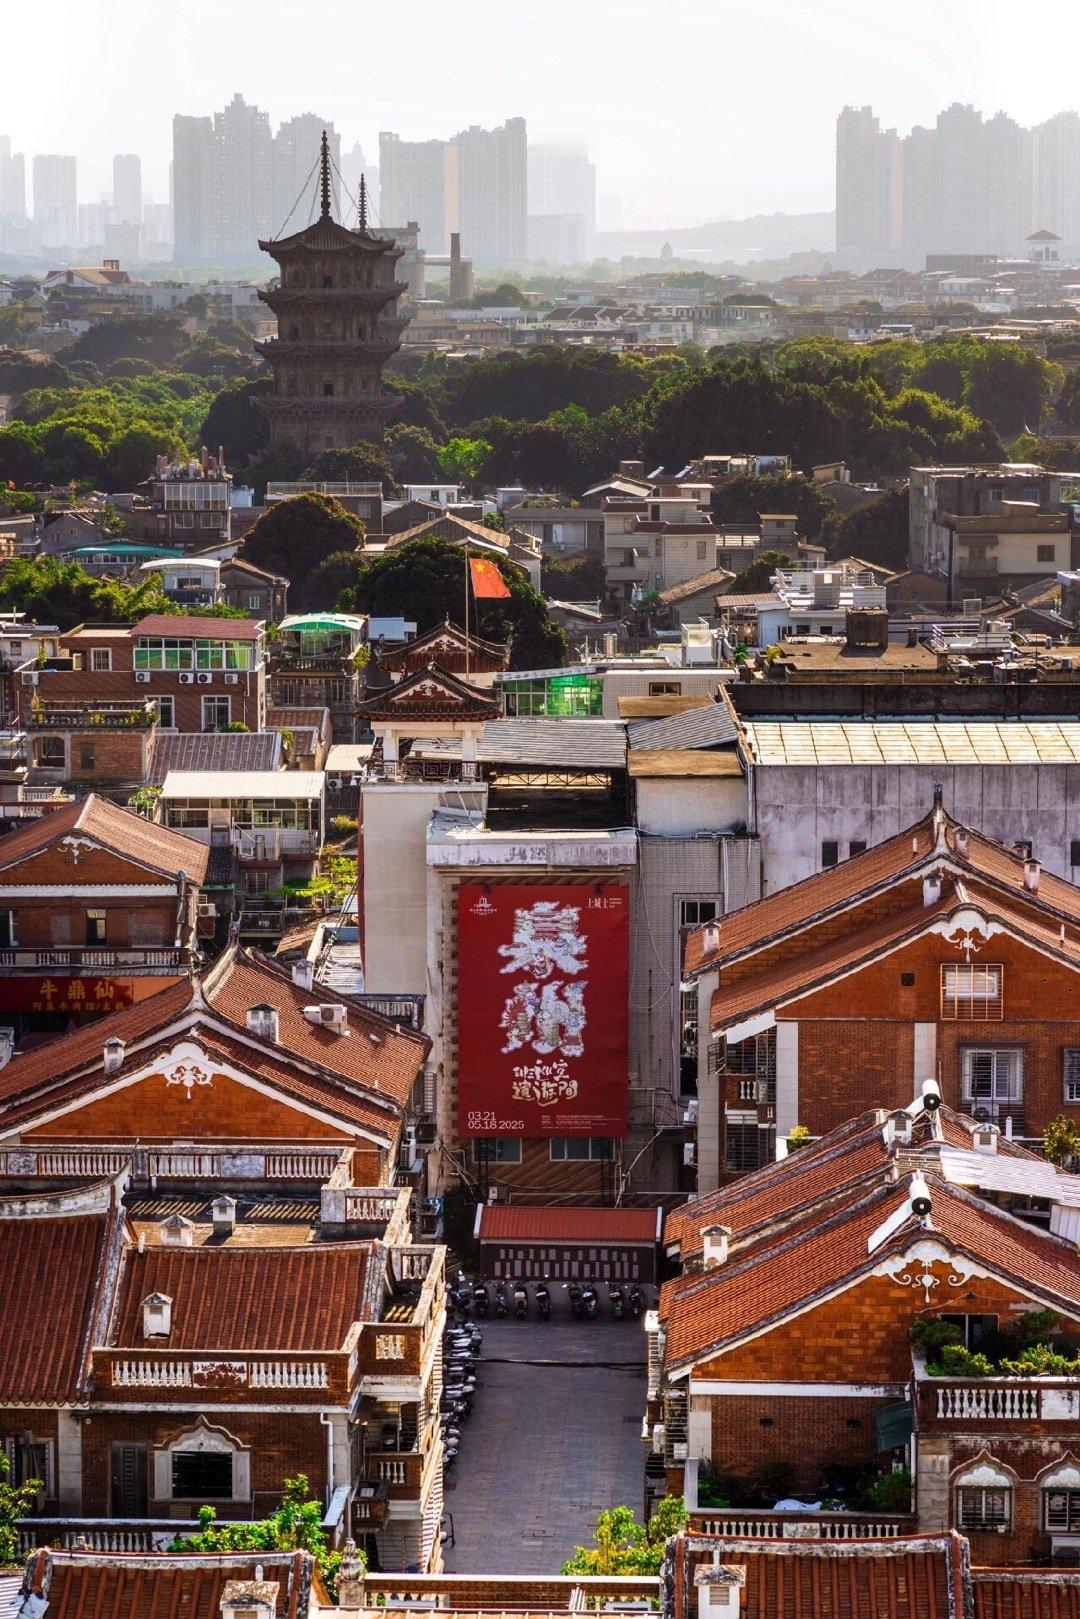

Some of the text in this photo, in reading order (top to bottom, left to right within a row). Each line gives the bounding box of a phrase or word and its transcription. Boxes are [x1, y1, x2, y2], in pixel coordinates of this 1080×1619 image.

[468, 1111, 497, 1120] 03.21
[468, 1120, 525, 1130] 05.18 2025
